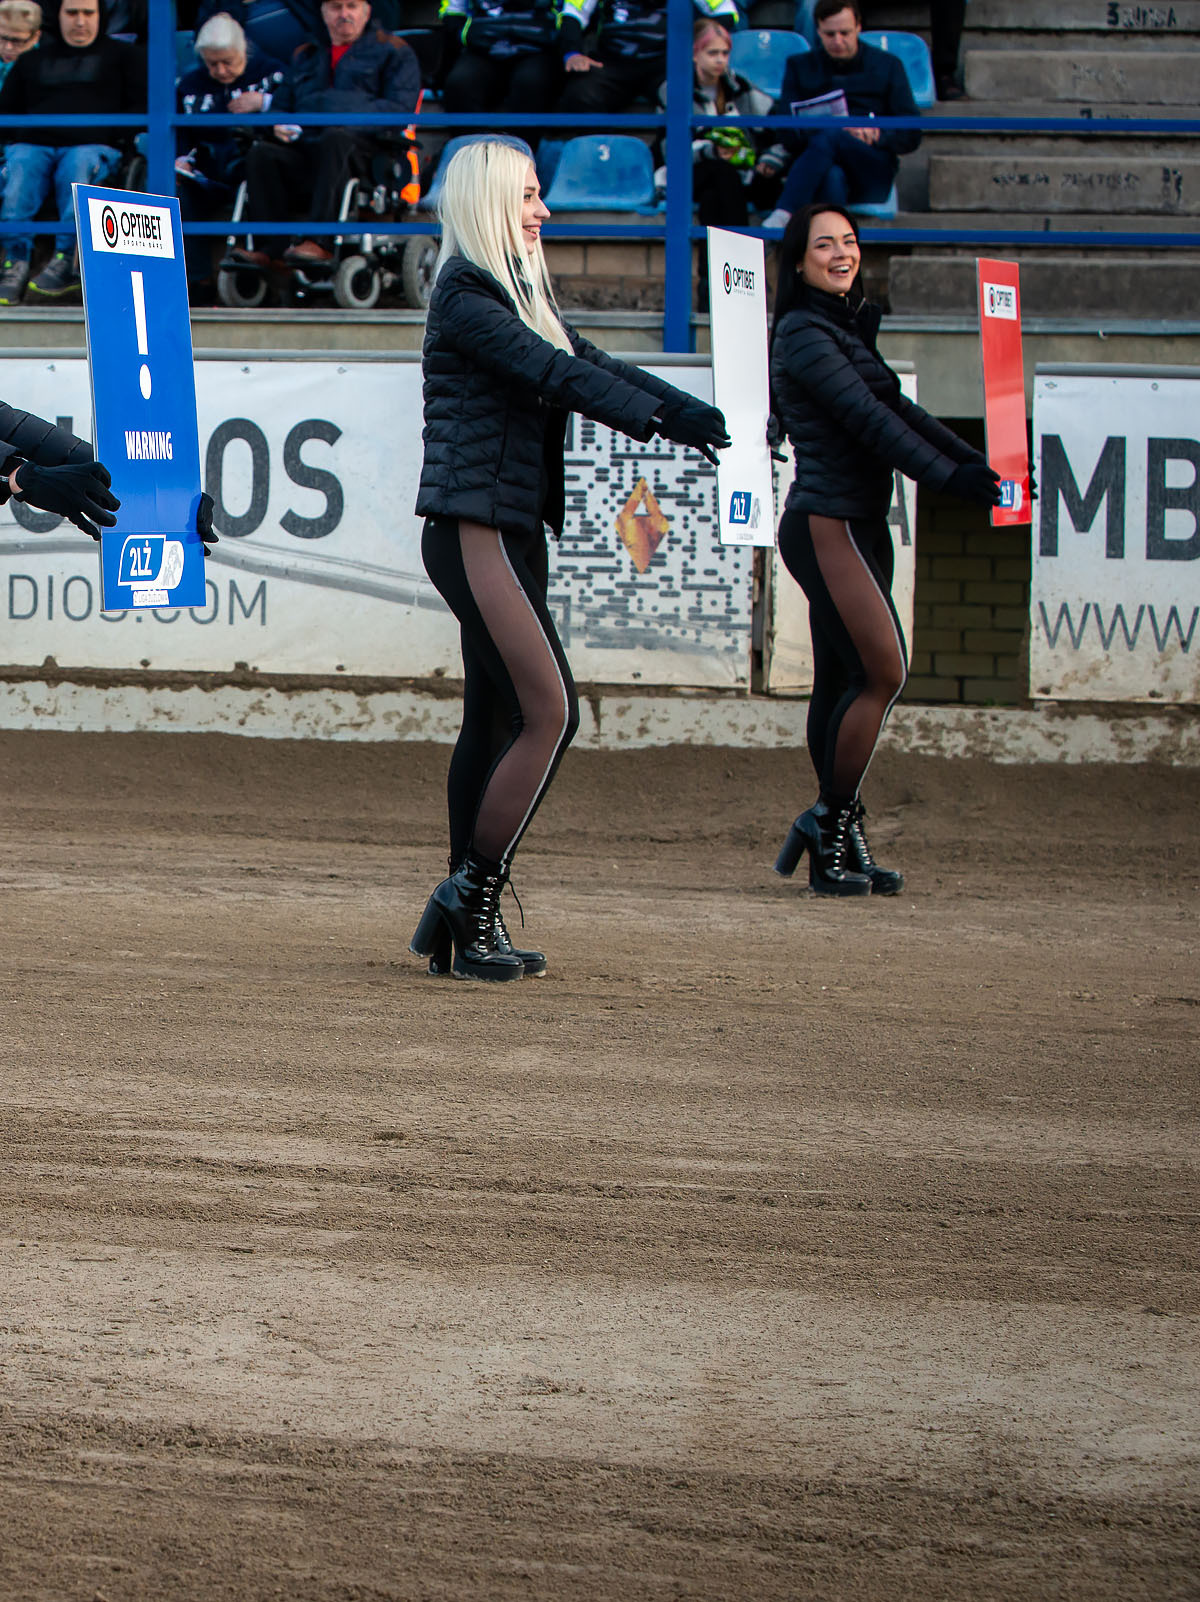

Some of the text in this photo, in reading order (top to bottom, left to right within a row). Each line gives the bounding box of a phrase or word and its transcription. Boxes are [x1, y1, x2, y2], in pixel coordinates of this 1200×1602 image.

[121, 211, 162, 241] OPTIBET
[733, 267, 755, 290] OPTIBET
[124, 431, 173, 460] WARNING
[1039, 433, 1200, 562] MB
[129, 540, 153, 576] 2LŻ
[1038, 601, 1200, 654] WWW
